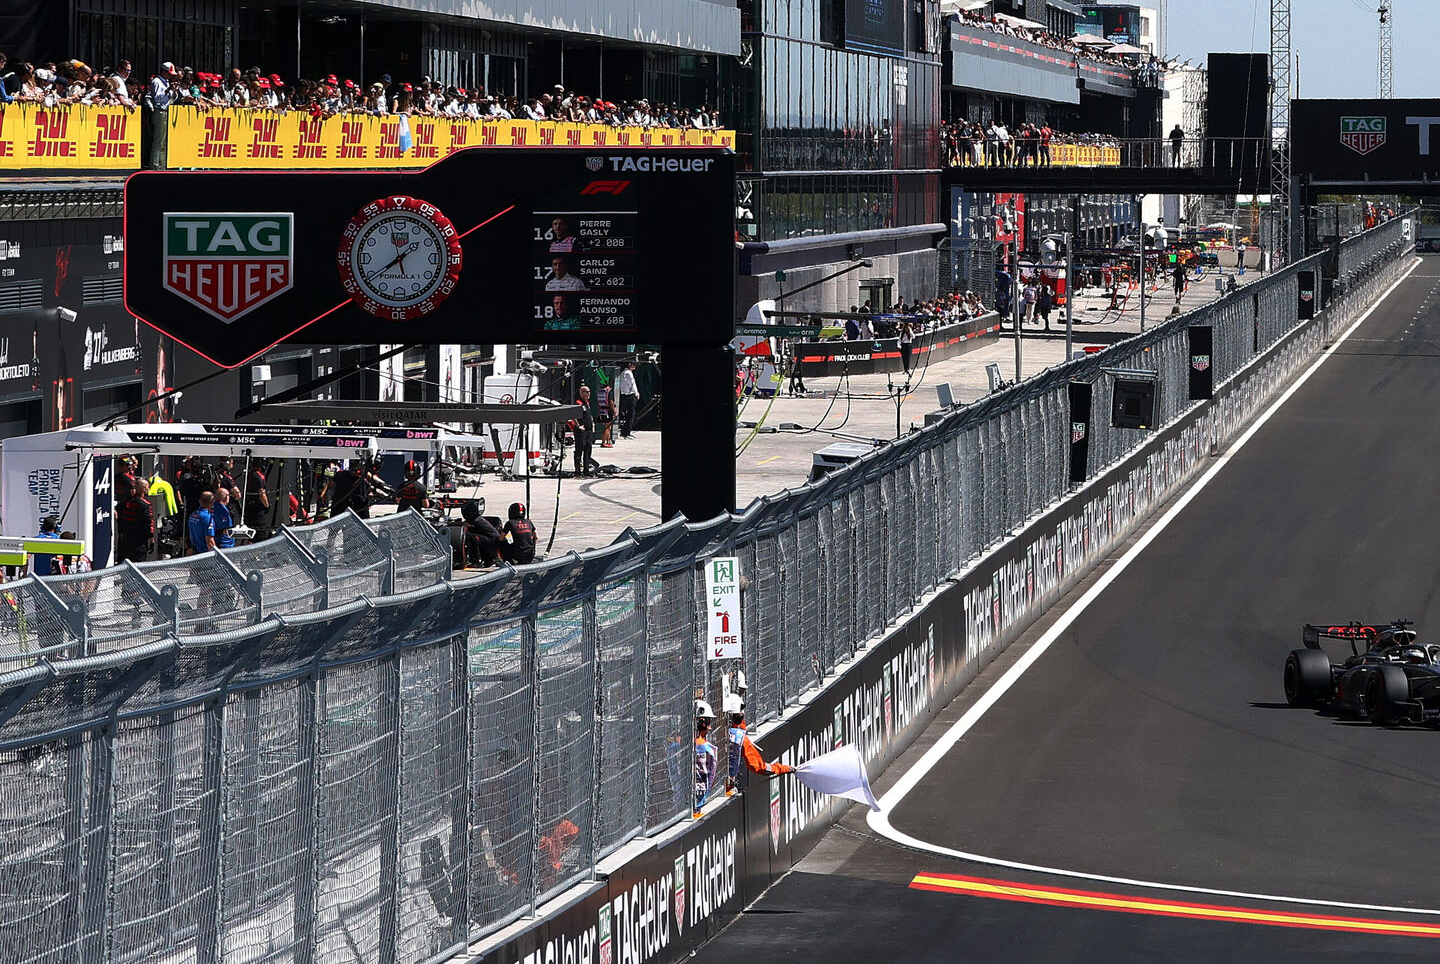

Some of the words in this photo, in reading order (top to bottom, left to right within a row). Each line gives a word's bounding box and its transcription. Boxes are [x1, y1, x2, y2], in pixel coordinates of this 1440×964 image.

[1344, 117, 1383, 131] TAG
[34, 111, 70, 157] DHL
[96, 114, 129, 157] DHL
[203, 117, 231, 158] DHL
[252, 119, 279, 158] DHL
[1342, 133, 1385, 152] HEUER
[363, 203, 378, 216] 55
[420, 203, 436, 216] 05
[175, 221, 280, 251] TAG
[443, 224, 454, 237] 10
[534, 228, 554, 240] 16
[452, 253, 460, 265] 15
[534, 267, 554, 279] 17
[172, 264, 284, 313] HEUER
[534, 306, 554, 318] 18
[28, 470, 38, 496] TEAM
[38, 469, 49, 514] FORMULA
[713, 585, 736, 595] EXIT
[714, 635, 737, 645] FIRE
